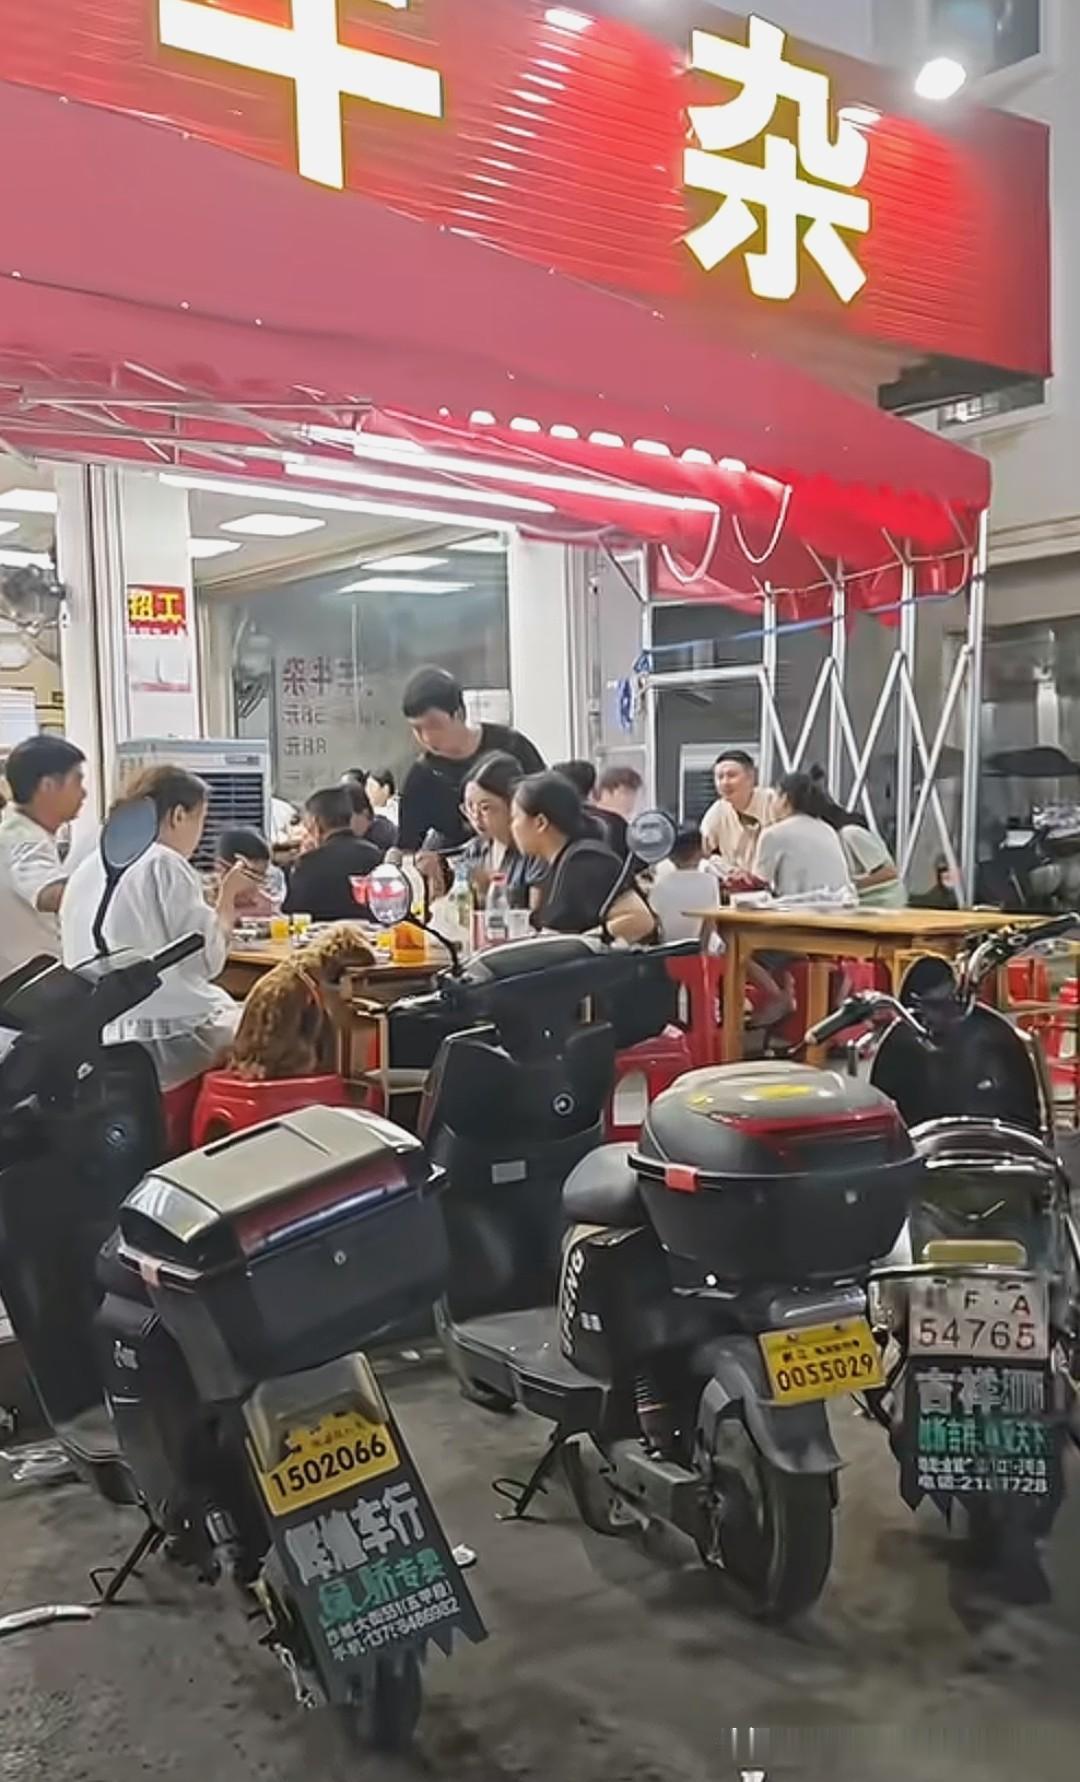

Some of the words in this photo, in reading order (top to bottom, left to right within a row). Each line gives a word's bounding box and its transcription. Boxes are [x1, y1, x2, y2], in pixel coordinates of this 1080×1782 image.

[128, 589, 183, 625] 招工
[918, 1317, 1036, 1352] 54765
[777, 1353, 874, 1393] 0055029
[270, 1433, 388, 1498] 1502066
